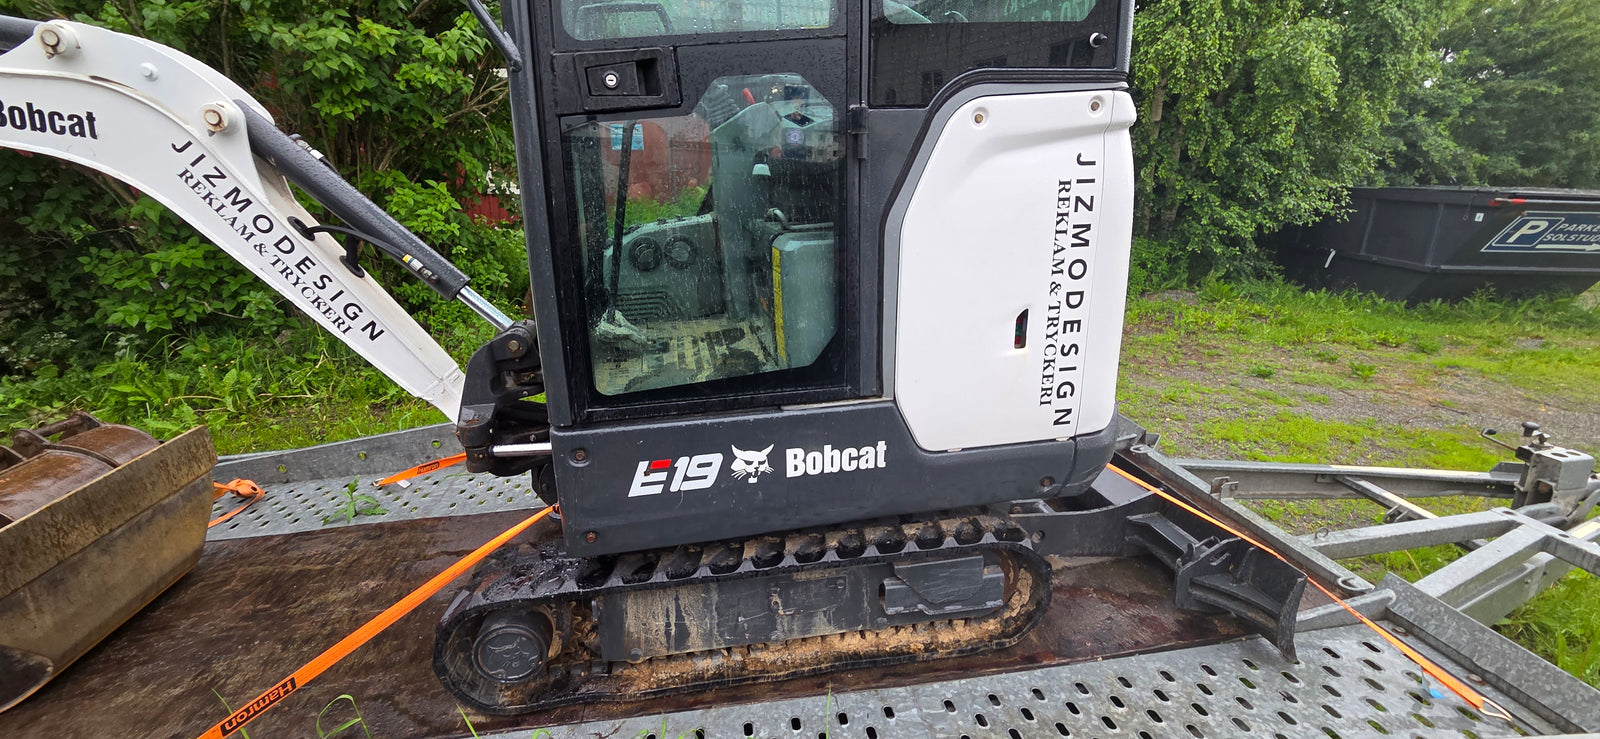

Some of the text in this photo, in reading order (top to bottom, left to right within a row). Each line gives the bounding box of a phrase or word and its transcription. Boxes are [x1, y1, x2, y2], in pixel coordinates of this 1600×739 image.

[172, 140, 385, 342] JIZMODESIGN
[177, 168, 354, 336] REKLAM & TRYCKERI
[1040, 178, 1072, 407] REKLAM & TRYCKERI
[1053, 152, 1096, 426] JIZMODESIGN
[1506, 220, 1549, 243] P
[628, 440, 887, 497] E19 Bobcat
[224, 681, 293, 731] Hamron
